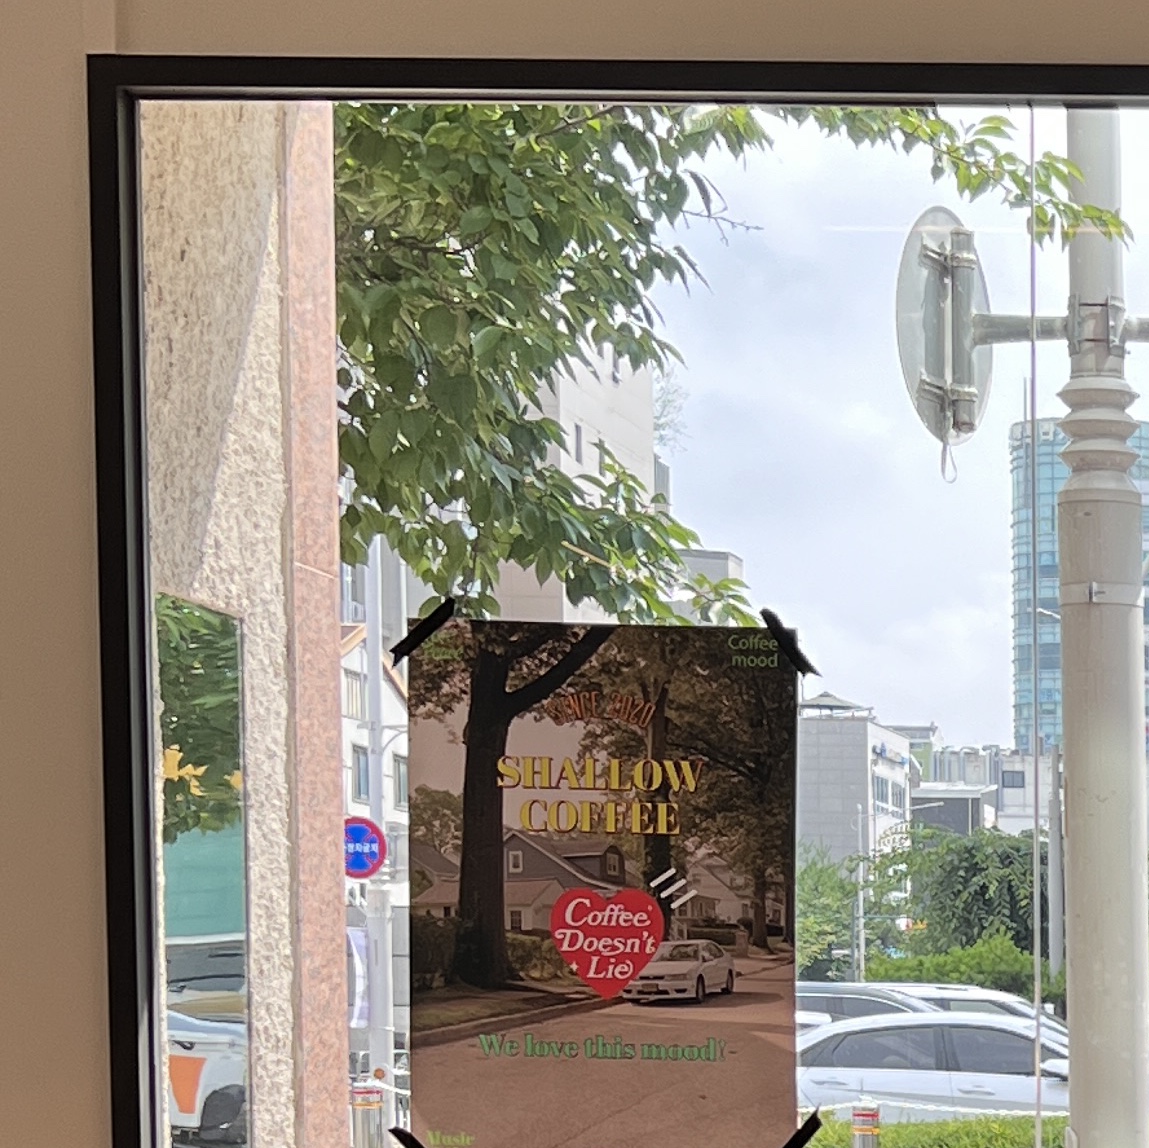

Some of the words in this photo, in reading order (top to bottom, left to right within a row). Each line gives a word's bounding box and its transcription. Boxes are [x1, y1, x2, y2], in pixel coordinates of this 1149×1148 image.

[728, 635, 779, 653] Coffee
[731, 653, 779, 668] mood
[545, 691, 600, 725] SINCE
[608, 692, 656, 728] 2020
[496, 755, 704, 793] SHALLOW
[520, 800, 681, 836] COFFEE
[565, 898, 653, 929] Coffee
[554, 930, 658, 955] Doesn't
[587, 958, 634, 980] Lie
[478, 1034, 519, 1058] We
[524, 1034, 579, 1059] love
[584, 1035, 636, 1060] this
[426, 1130, 475, 1146] Music
